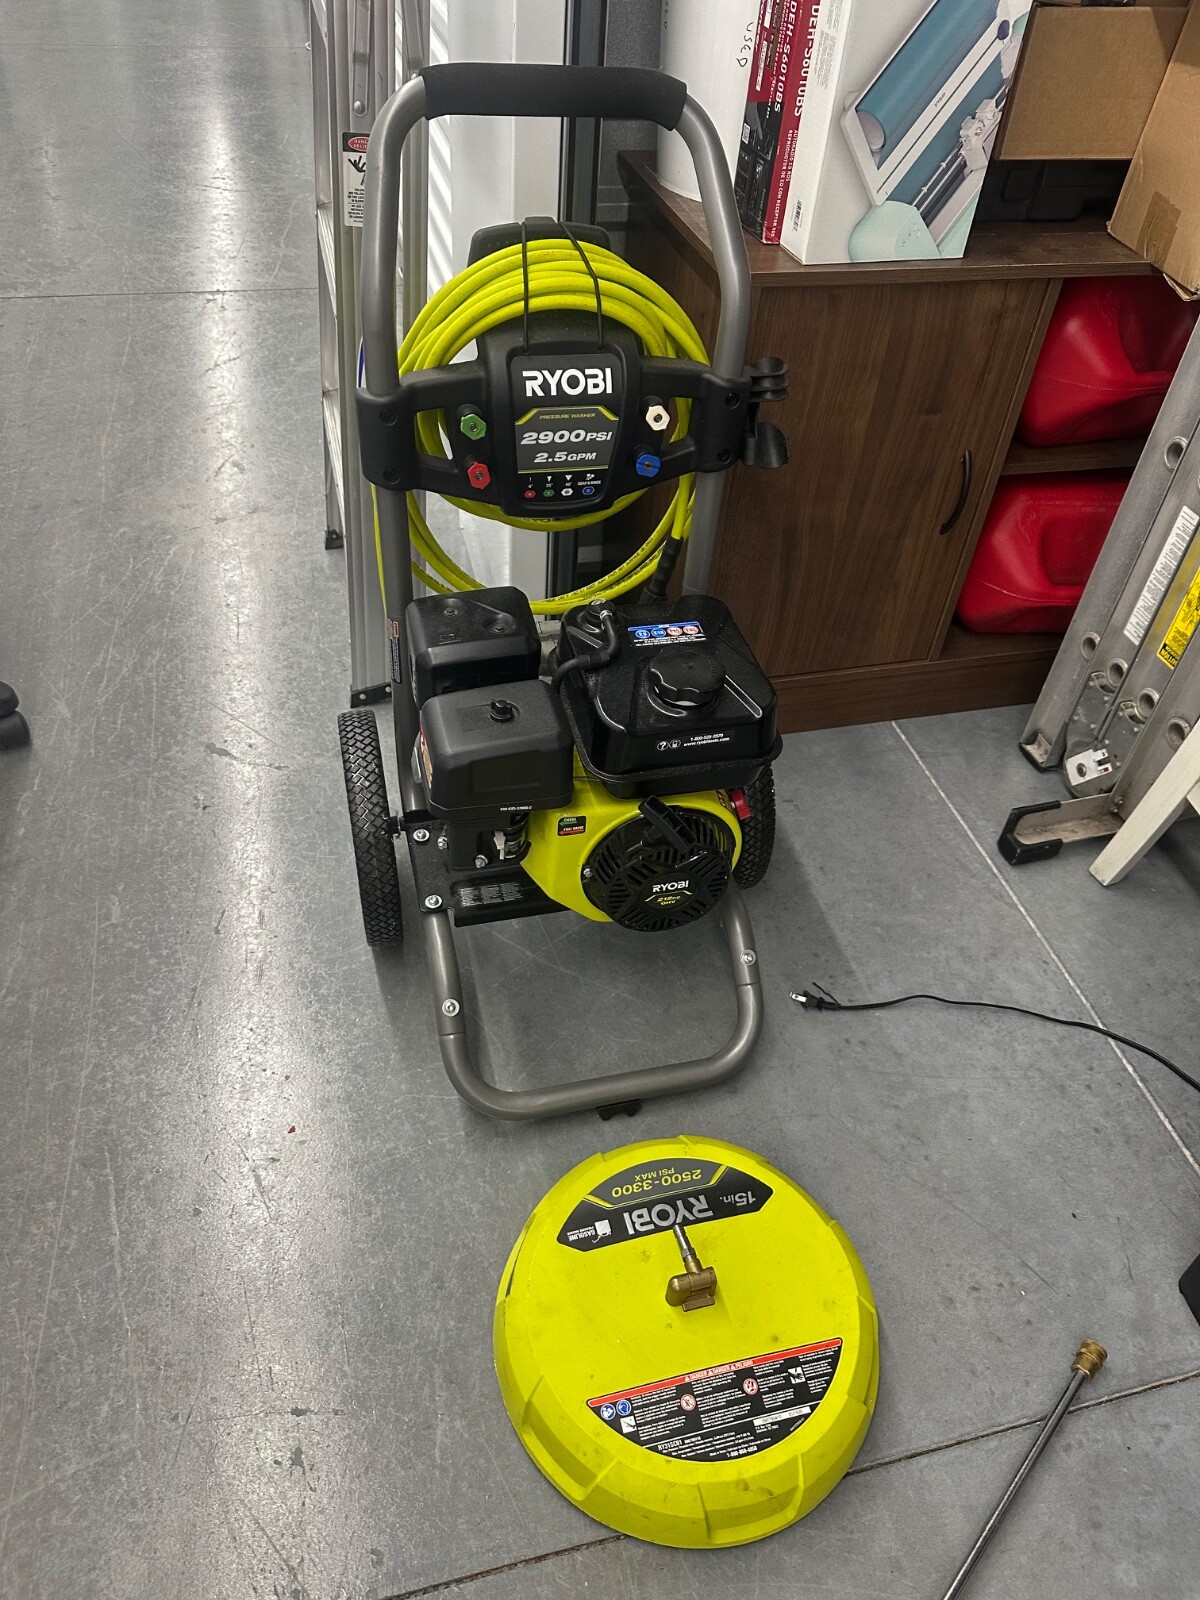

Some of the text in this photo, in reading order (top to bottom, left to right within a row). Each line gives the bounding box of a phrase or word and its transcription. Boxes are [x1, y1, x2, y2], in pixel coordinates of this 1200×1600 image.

[736, 21, 754, 68] USED
[774, 0, 798, 113] DEH-S6010BS
[782, 129, 793, 171] REPRODUCTOR
[522, 367, 613, 397] RYOBI
[539, 412, 597, 421] PRESSURE WASHER
[520, 429, 613, 445] 2900PSI
[533, 451, 597, 463] 2.5GPM
[652, 880, 690, 893] RYOBI
[634, 1167, 676, 1182] PSI MAX
[622, 1194, 714, 1235] RYOBI
[568, 1227, 597, 1242] GASOLINE
